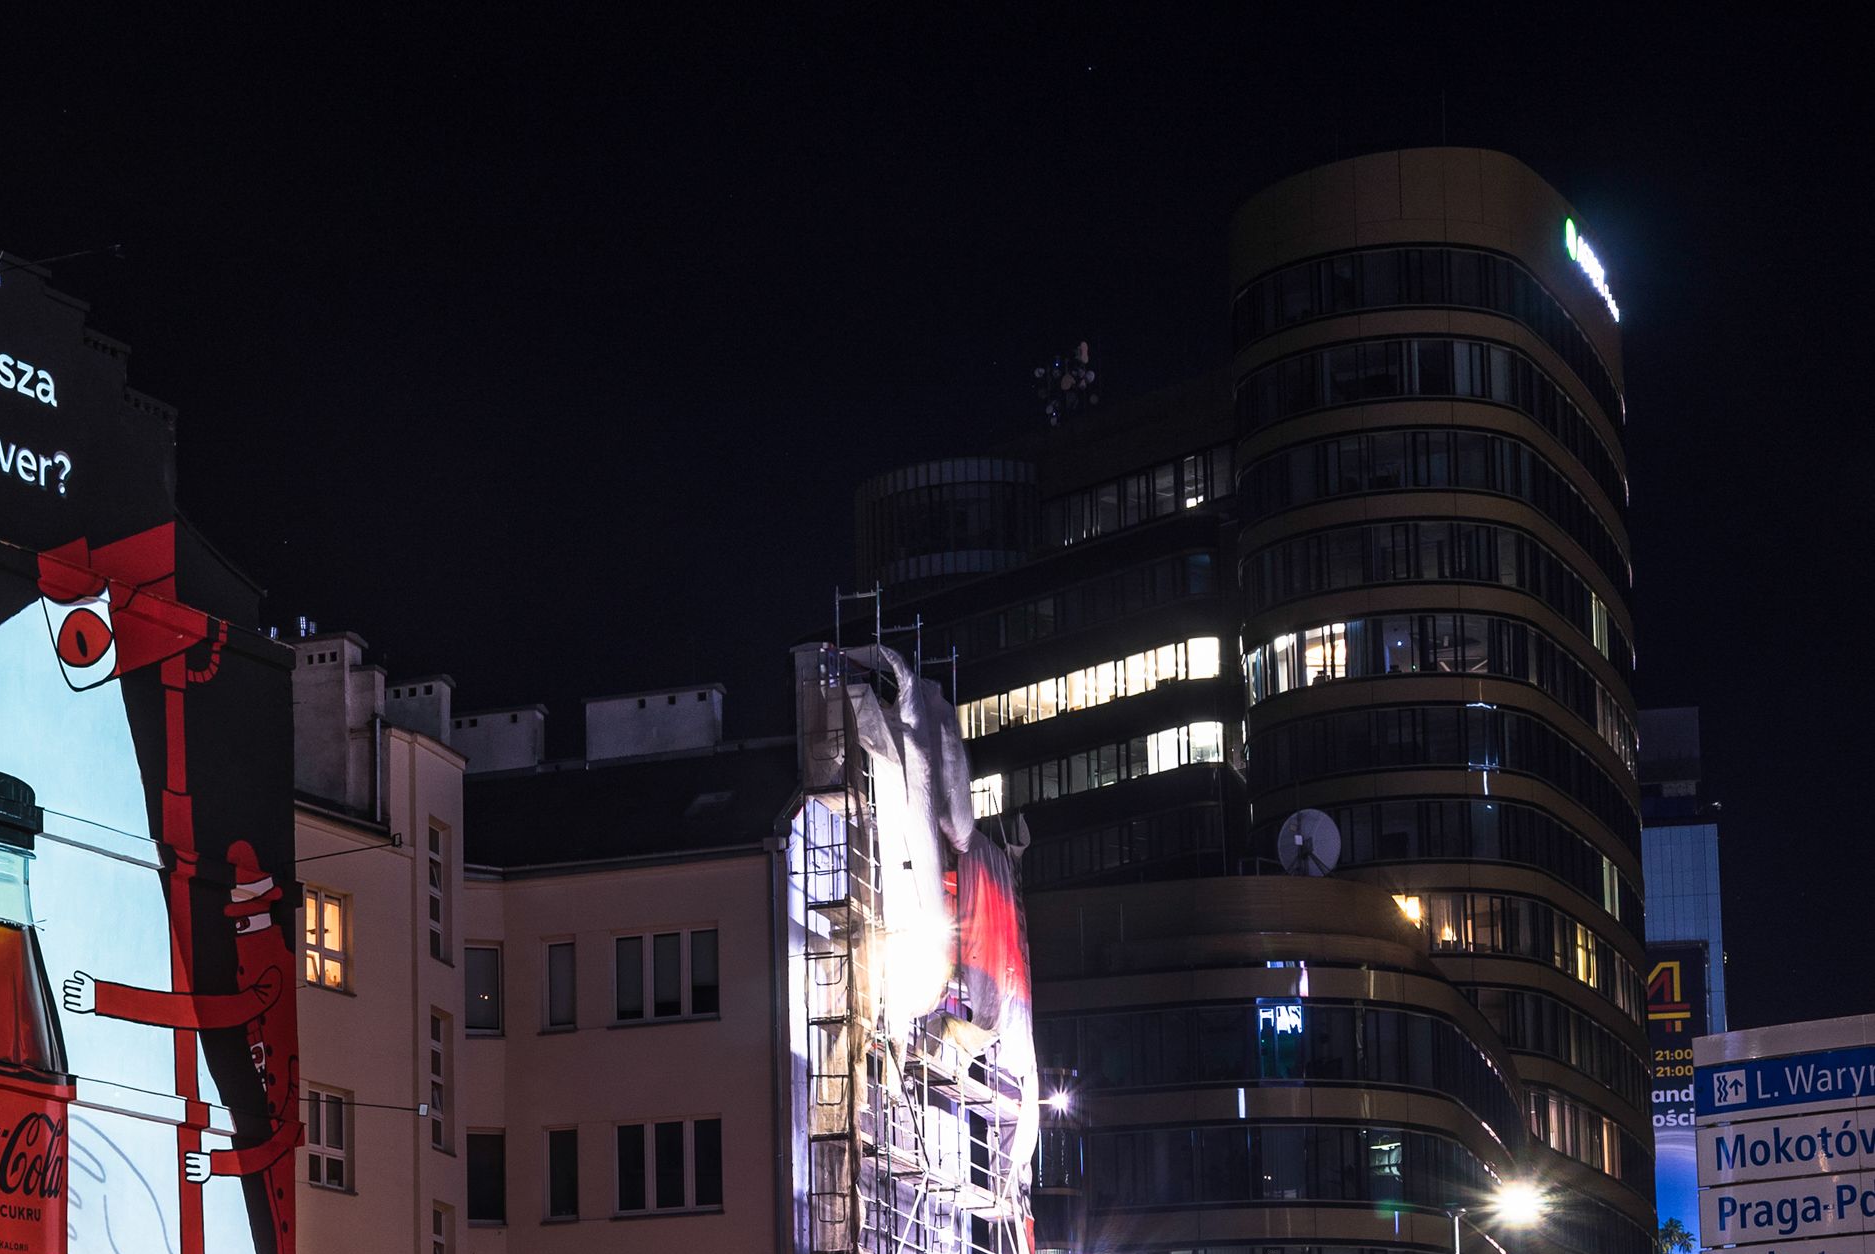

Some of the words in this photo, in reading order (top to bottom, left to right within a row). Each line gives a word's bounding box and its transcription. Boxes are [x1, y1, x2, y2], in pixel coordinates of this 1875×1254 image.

[1655, 1048, 1693, 1061] 21:00
[1655, 1065, 1694, 1078] 21:00
[1756, 1070, 1779, 1099] L.
[0, 1204, 42, 1221] CUKRU
[1718, 1182, 1875, 1236] Praga-Po
